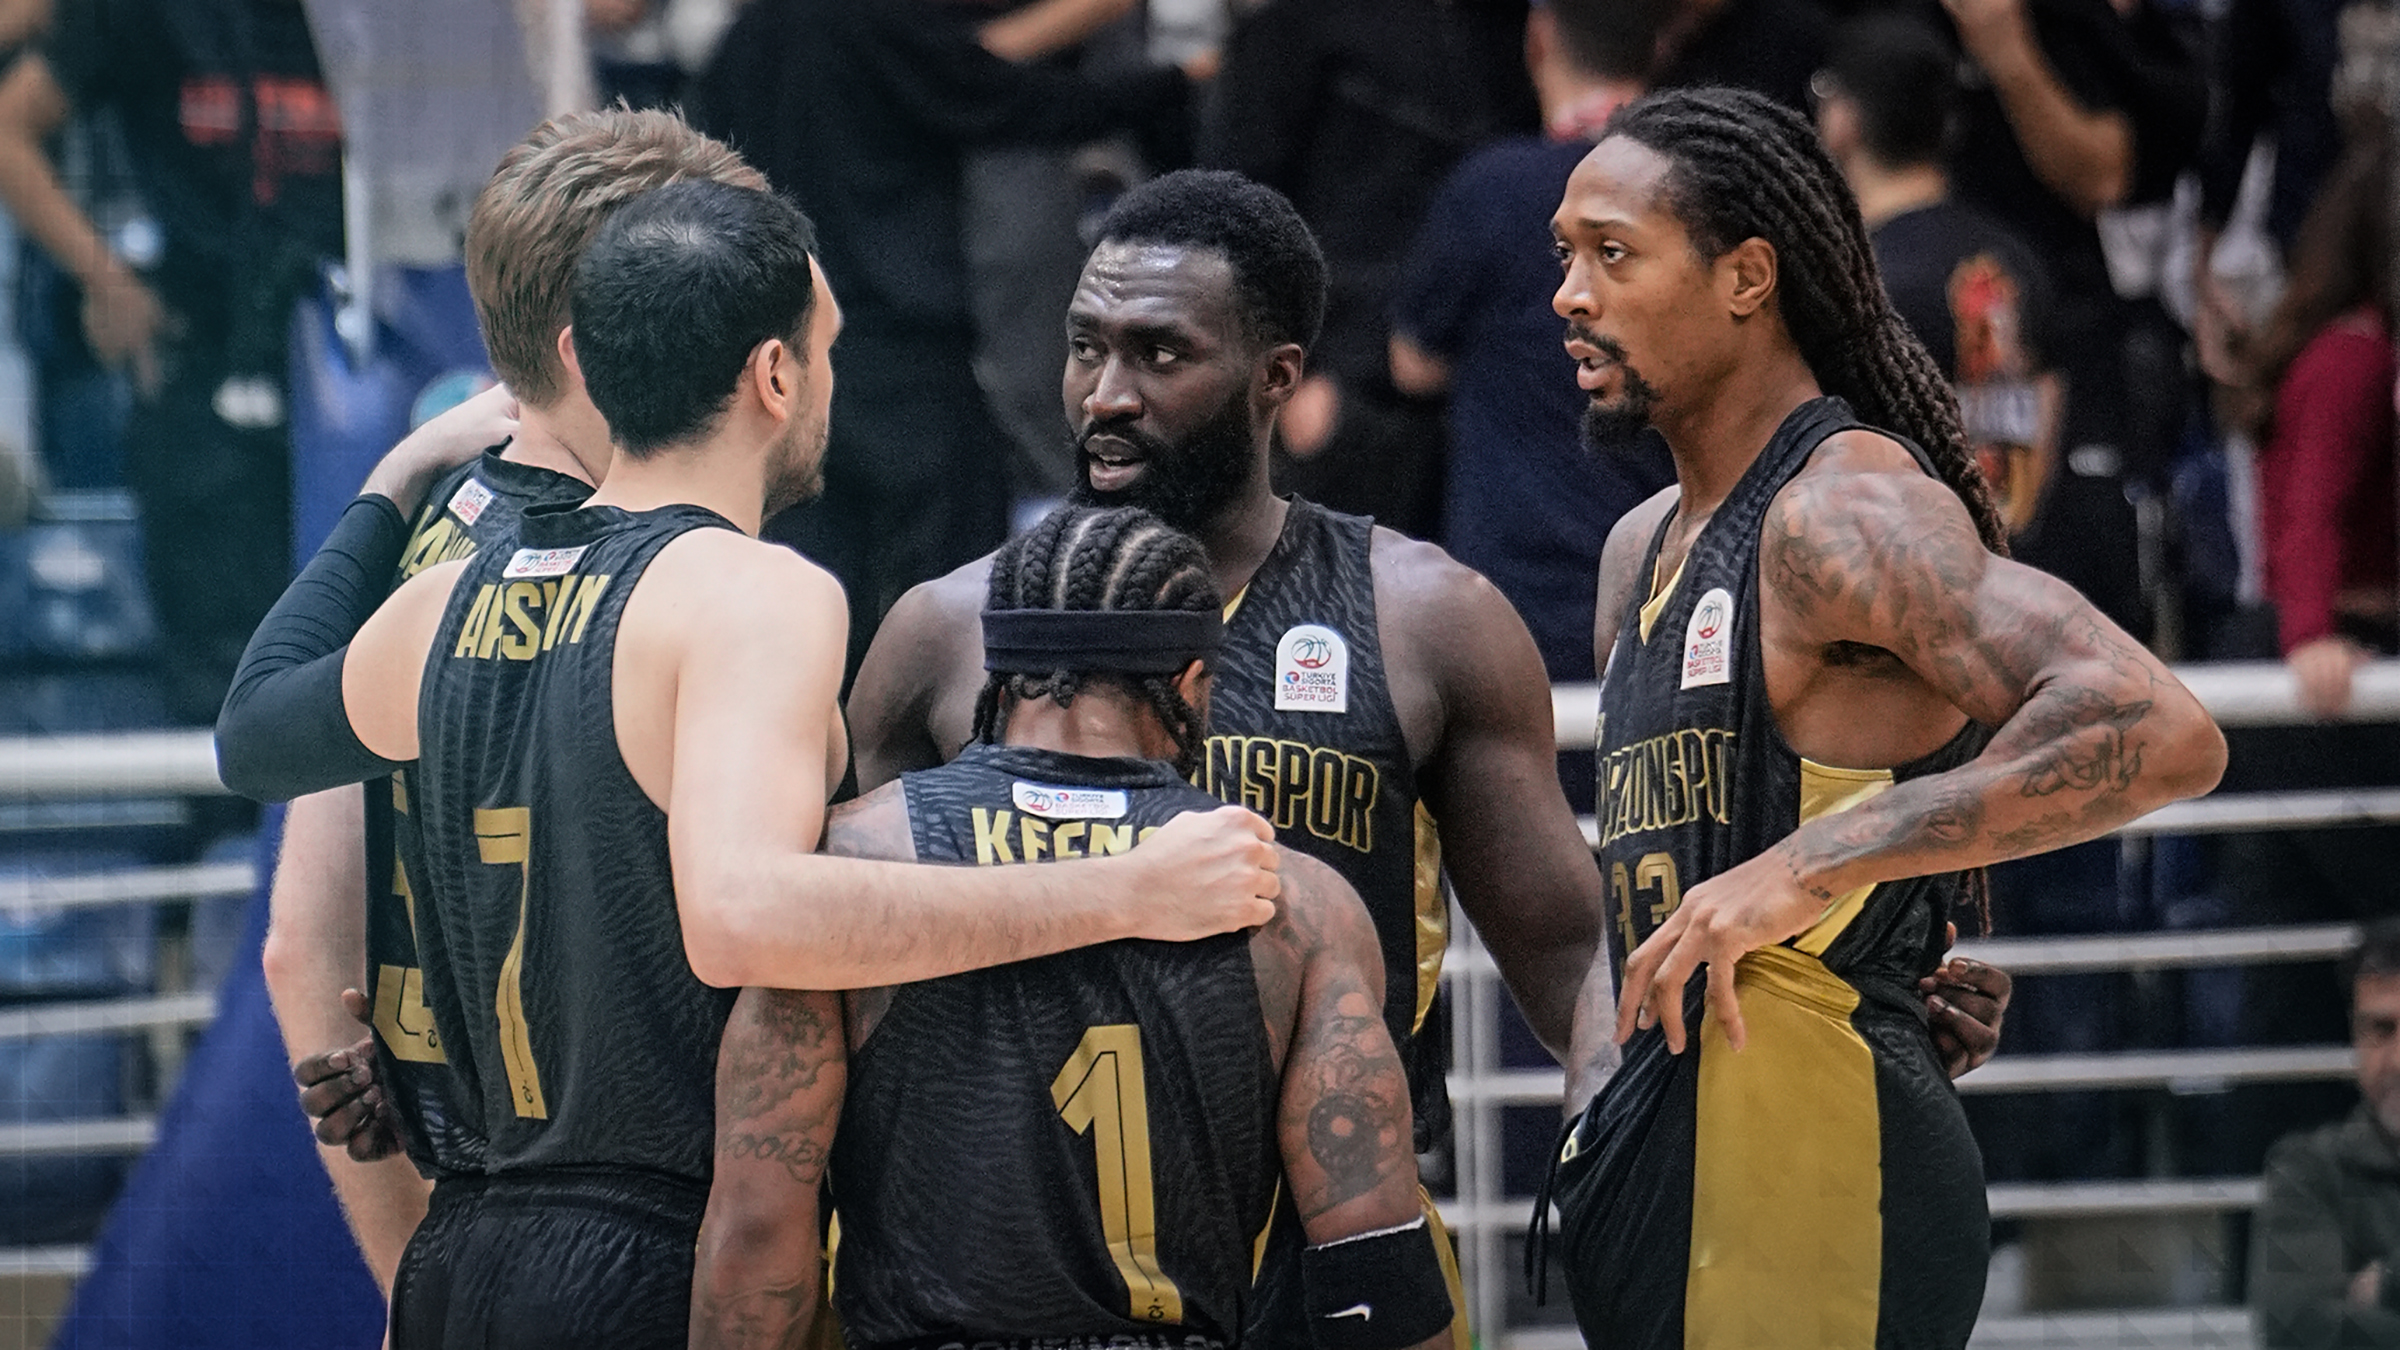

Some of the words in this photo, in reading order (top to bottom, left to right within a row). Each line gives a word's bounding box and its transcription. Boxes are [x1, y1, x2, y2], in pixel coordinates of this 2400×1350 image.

[1282, 684, 1339, 694] BASKETBOL
[473, 806, 548, 1120] 7
[1050, 1024, 1183, 1325] 1
